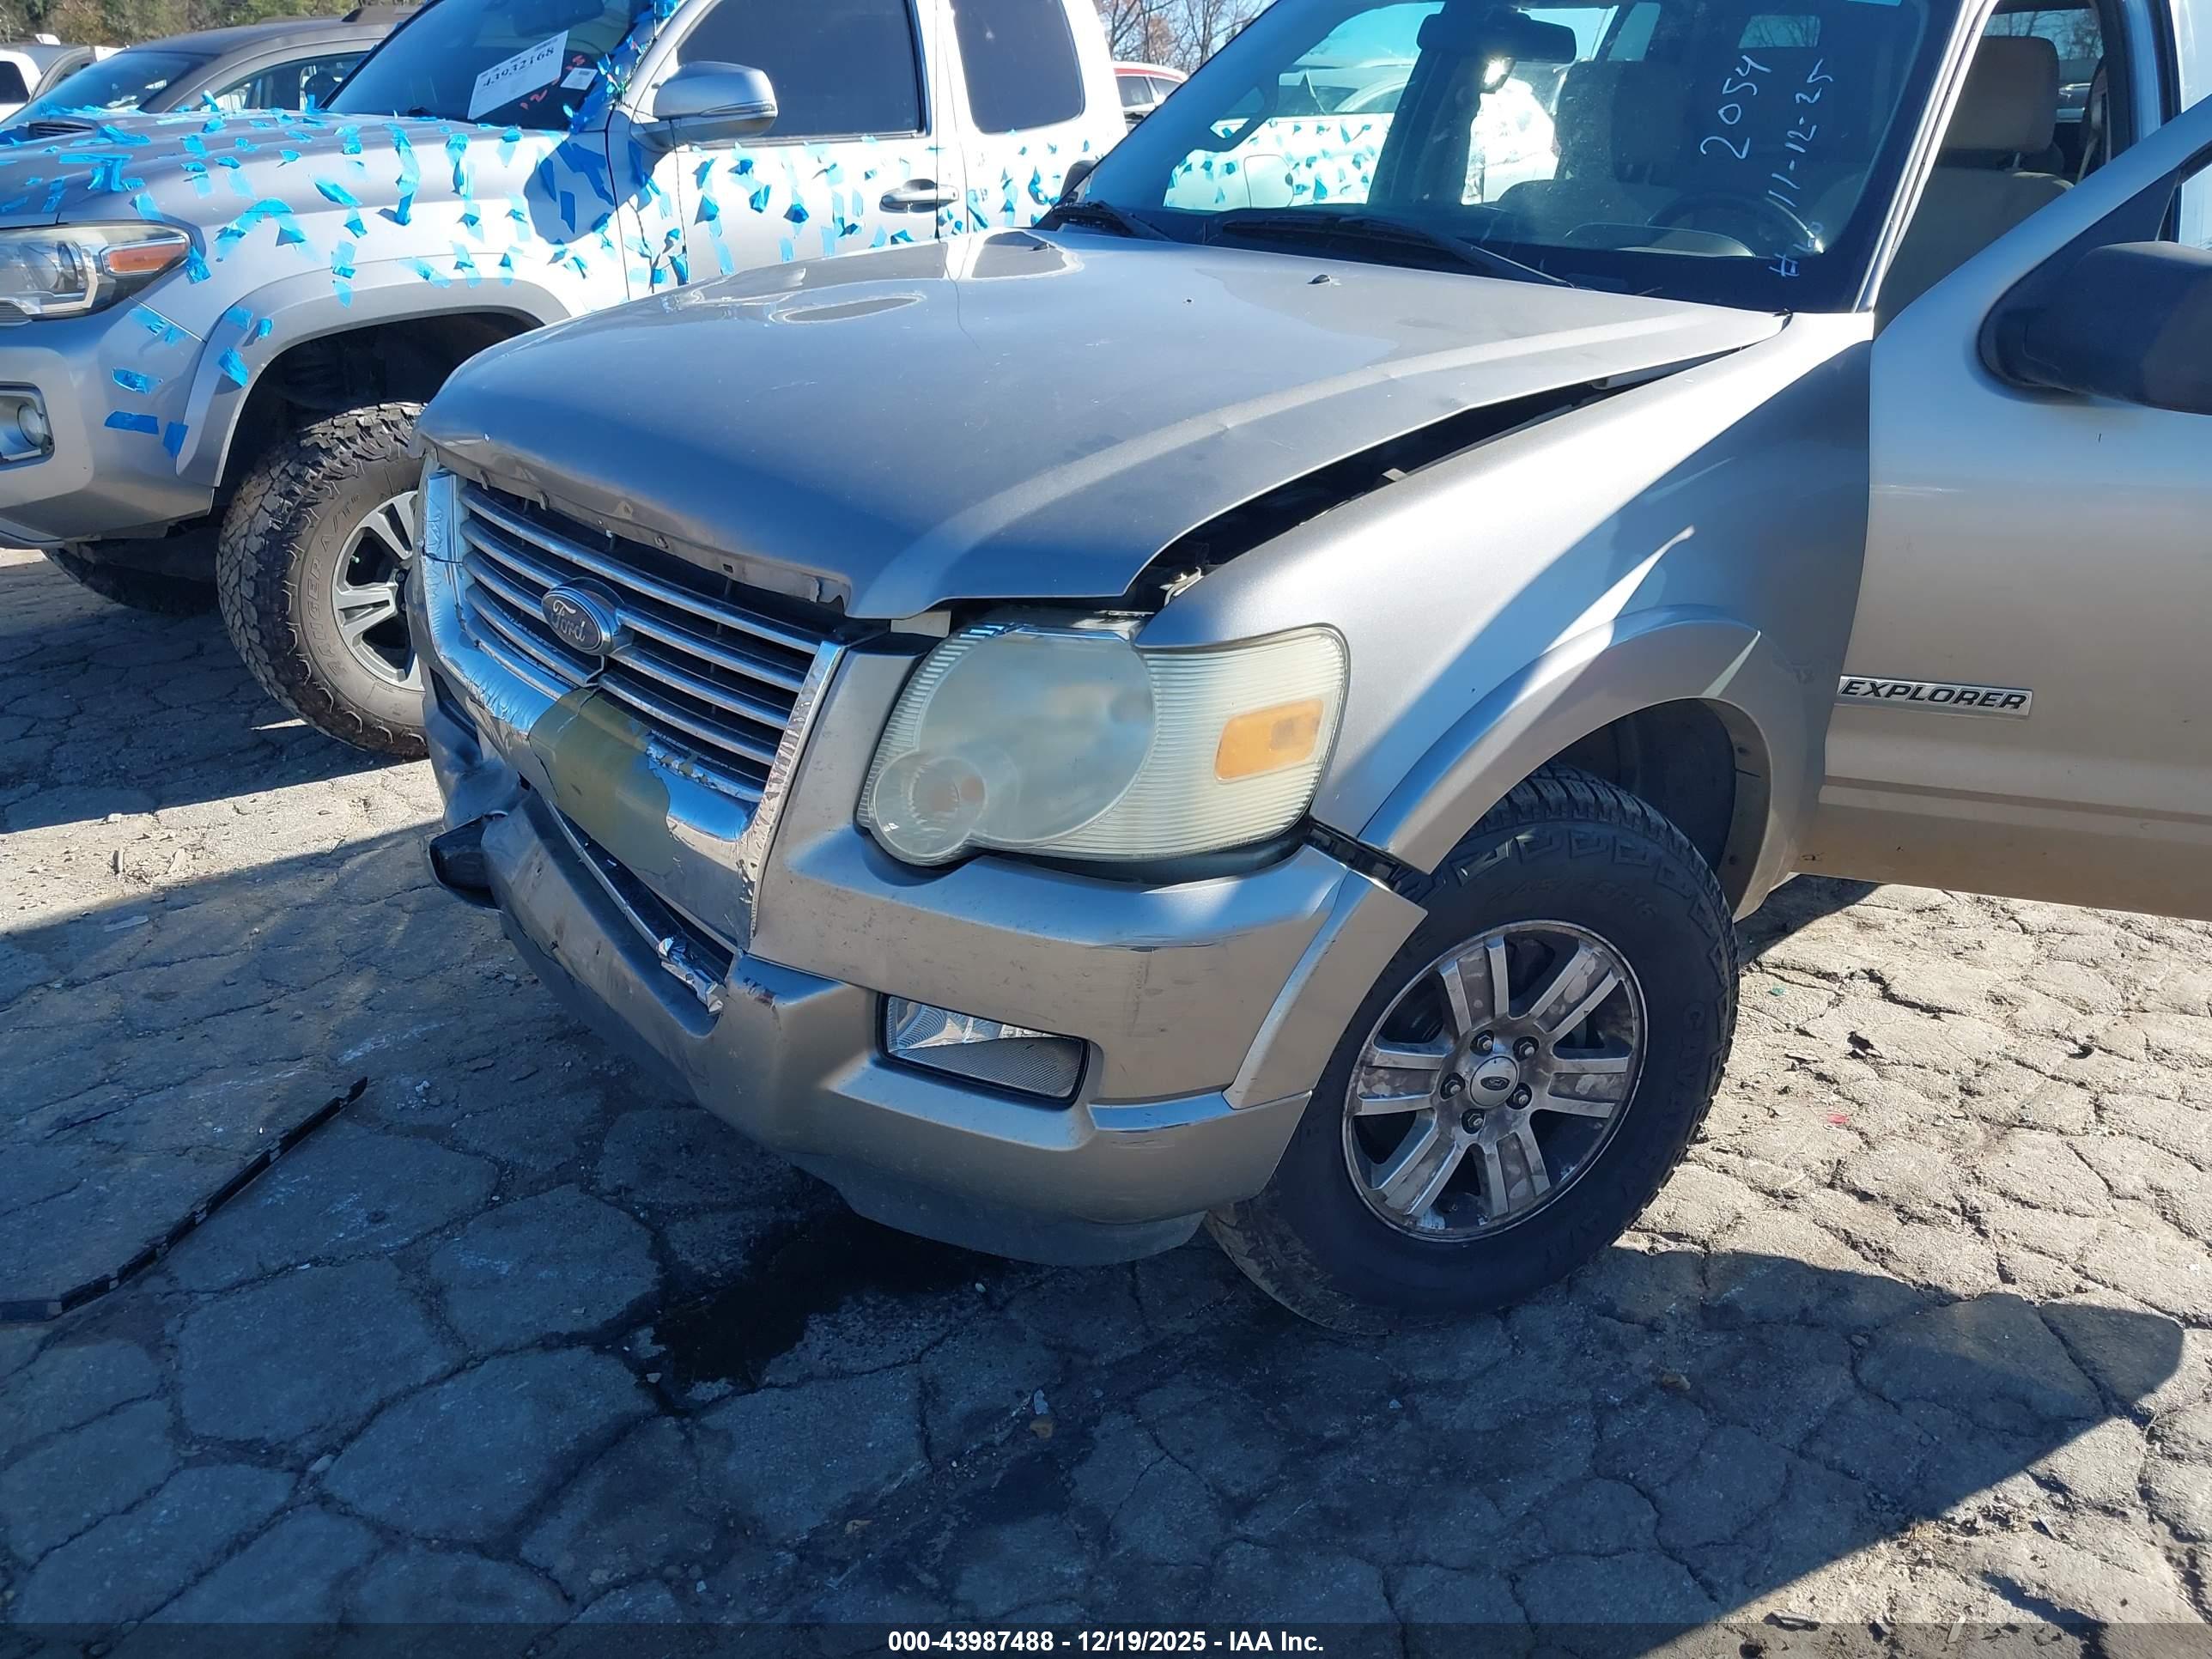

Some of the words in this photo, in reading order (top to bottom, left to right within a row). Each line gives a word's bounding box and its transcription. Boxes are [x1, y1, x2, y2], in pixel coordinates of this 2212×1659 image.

[1699, 54, 1772, 160] 2054
[1767, 58, 1834, 208] 11-12-25
[551, 599, 586, 643] Ford
[1840, 679, 2028, 710] EXPLORER
